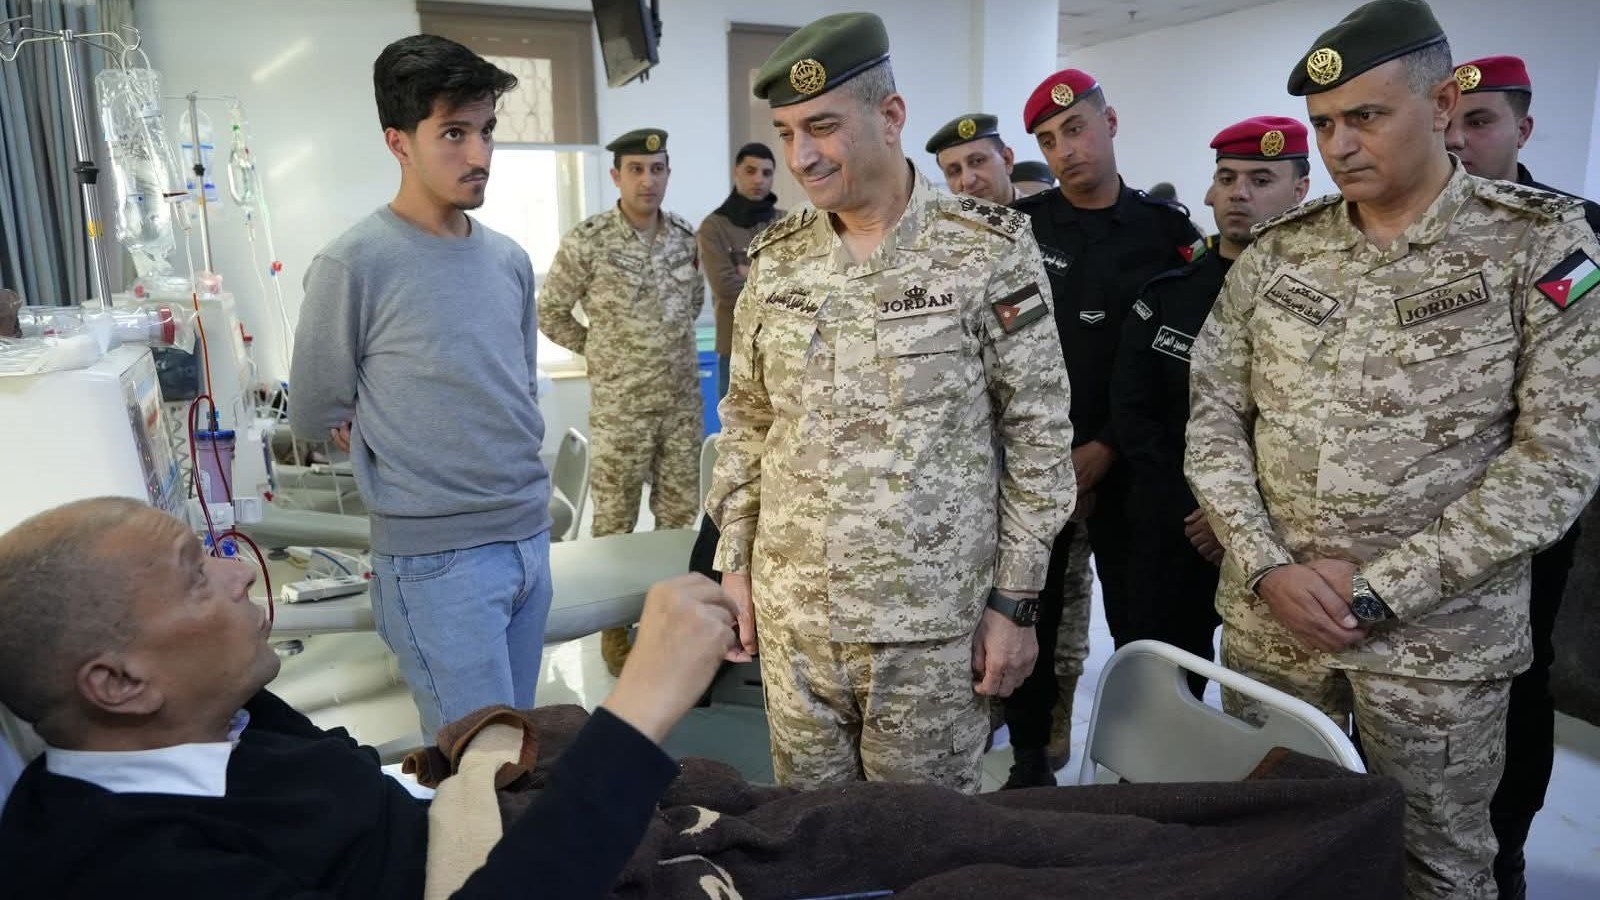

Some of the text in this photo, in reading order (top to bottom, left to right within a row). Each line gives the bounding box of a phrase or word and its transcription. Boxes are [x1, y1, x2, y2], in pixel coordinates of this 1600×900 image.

[882, 293, 953, 313] JORDAN
[1288, 287, 1323, 304] الدكتور
[1405, 287, 1482, 322] JORDAN
